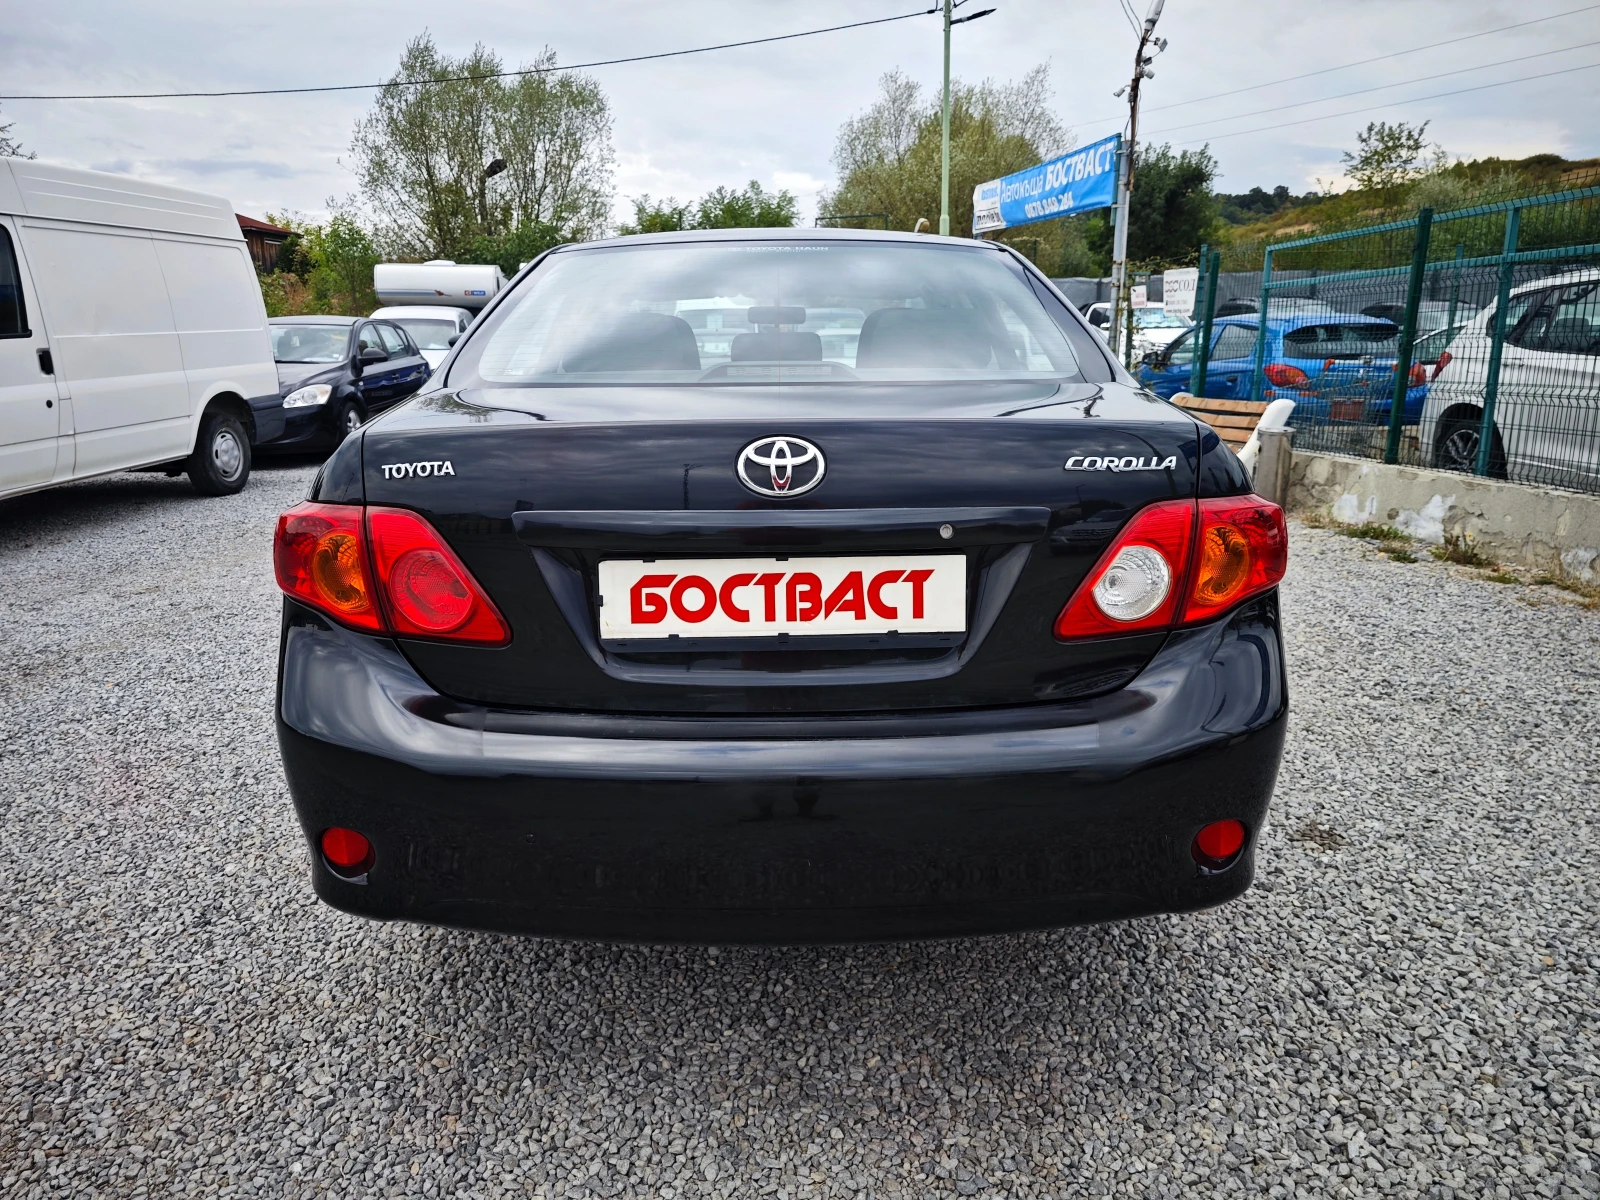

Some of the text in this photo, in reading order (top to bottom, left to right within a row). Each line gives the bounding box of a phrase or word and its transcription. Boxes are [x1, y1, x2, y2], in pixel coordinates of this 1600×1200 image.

[1045, 142, 1115, 191] БОСТВАСТ
[381, 460, 456, 480] TOYOTA
[1064, 455, 1177, 473] COROLLA
[629, 568, 936, 625] БОСТВАСТ
